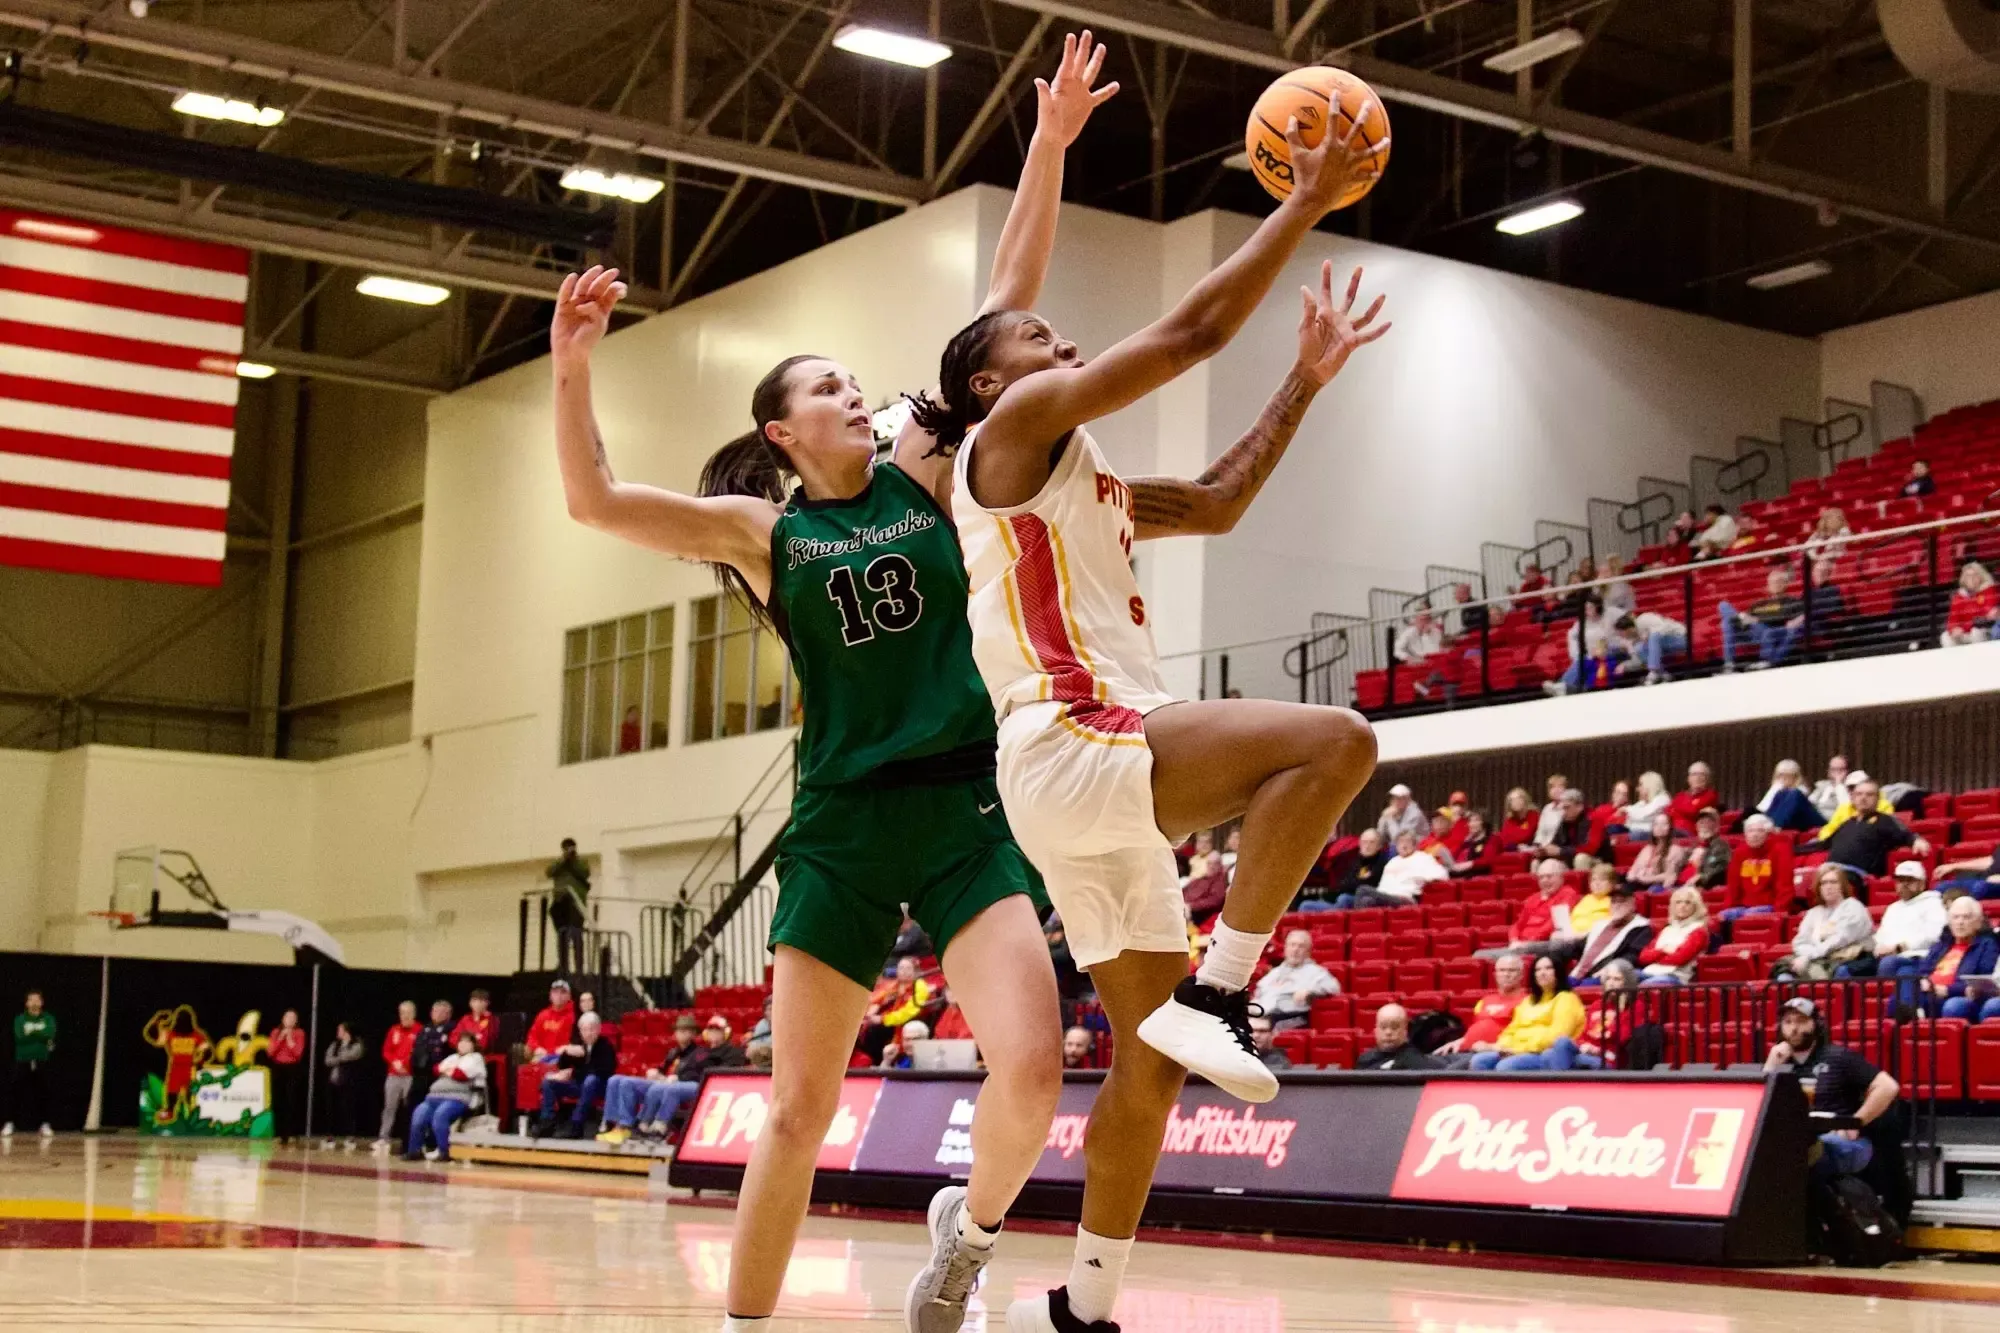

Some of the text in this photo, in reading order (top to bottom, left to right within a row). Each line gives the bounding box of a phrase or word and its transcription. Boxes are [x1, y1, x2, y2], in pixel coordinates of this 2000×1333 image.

[786, 509, 935, 570] RiverHawks
[825, 553, 924, 647] 13
[1413, 1103, 1666, 1182] Pitt State
